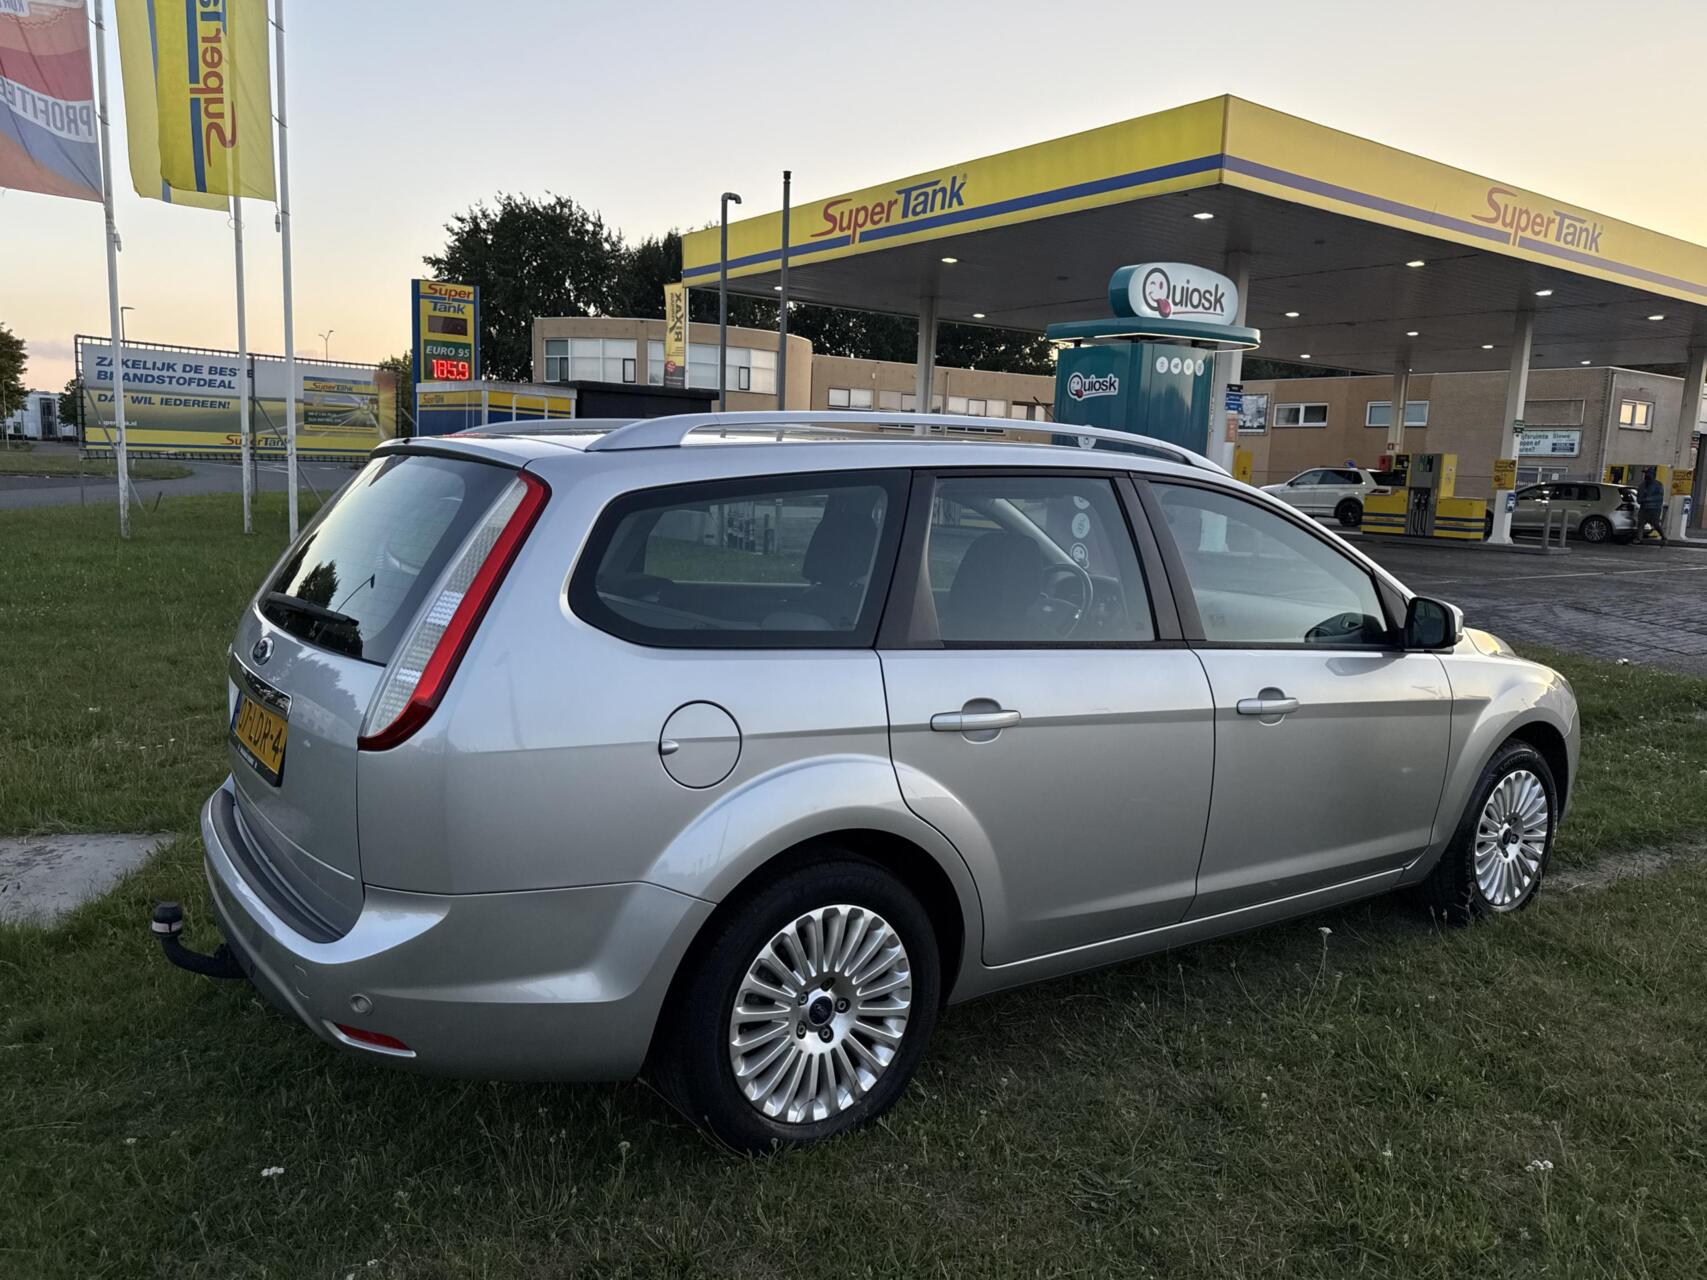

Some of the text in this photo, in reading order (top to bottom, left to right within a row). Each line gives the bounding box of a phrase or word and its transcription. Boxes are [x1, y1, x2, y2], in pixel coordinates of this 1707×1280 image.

[810, 173, 968, 244] SuperTank
[1471, 187, 1605, 253] SuperTank
[427, 283, 473, 301] Super
[1142, 267, 1225, 318] Quiosk
[429, 301, 466, 315] Tank
[426, 345, 470, 357] EURO 95
[182, 364, 205, 375] DE
[208, 366, 254, 378] BESE
[1069, 374, 1117, 398] Quiosk
[131, 395, 155, 405] WIL
[160, 397, 231, 409] IEDEREEN!
